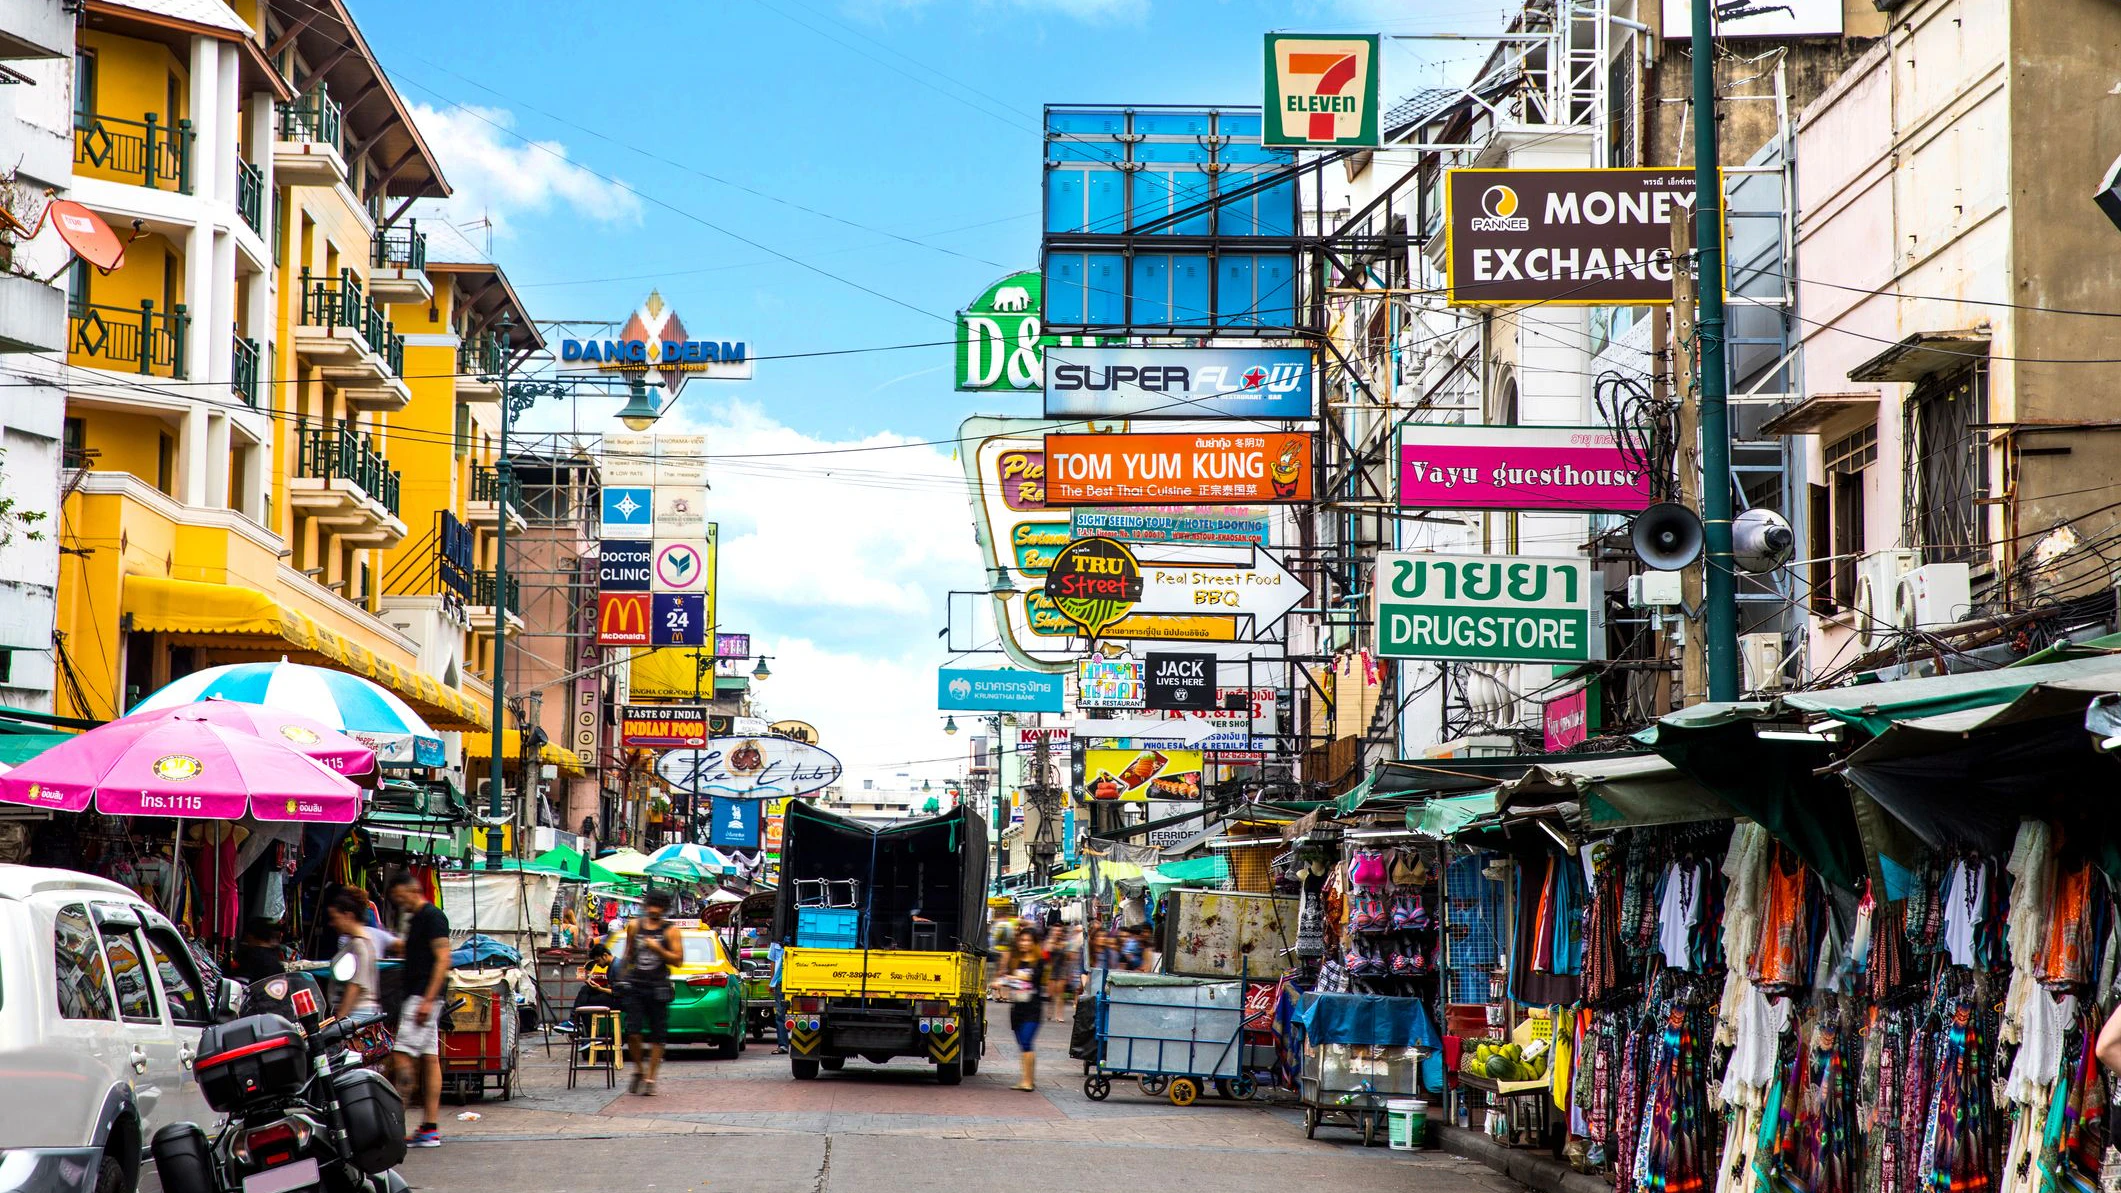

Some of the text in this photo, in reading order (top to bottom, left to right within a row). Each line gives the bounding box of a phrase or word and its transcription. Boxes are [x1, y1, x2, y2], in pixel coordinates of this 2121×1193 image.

[1472, 218, 1530, 231] PANNEE
[1473, 248, 1697, 281] EXCHANG
[562, 339, 745, 364] DANG DERM
[680, 363, 708, 372] Hotel
[1053, 452, 1264, 479] TOM YUM KUNG
[1411, 460, 1640, 488] Vayu guesthouse
[1061, 485, 1192, 496] The Best Thai Cuisine
[1077, 514, 1107, 526] SIGHT
[1109, 515, 1143, 527] SEEING
[1145, 517, 1172, 528] TOUR
[1184, 518, 1214, 530] HOTEL
[1217, 520, 1262, 531] BOOKING
[600, 552, 650, 562] DOCTOR
[1071, 555, 1125, 575] TRU
[600, 568, 650, 580] CLINIC
[1156, 571, 1281, 585] Real Street Food
[1391, 560, 1578, 603] ขายยา
[1061, 574, 1129, 599] Street
[1193, 590, 1240, 607] BBQ
[666, 612, 689, 628] 24
[601, 632, 646, 640] McDonald's
[1391, 614, 1577, 649] DRUGSTORE
[1156, 661, 1204, 677] JACK
[974, 680, 1051, 694] ธนาคารกรุงไทย
[1156, 677, 1180, 686] LIVES
[627, 710, 702, 719] TASTE OF INDIA
[578, 692, 595, 764] FOOD
[624, 721, 704, 737] INDIAN FOOD
[1201, 742, 1208, 750] &
[678, 751, 831, 786] The Club
[140, 789, 202, 810] โทร.1115
